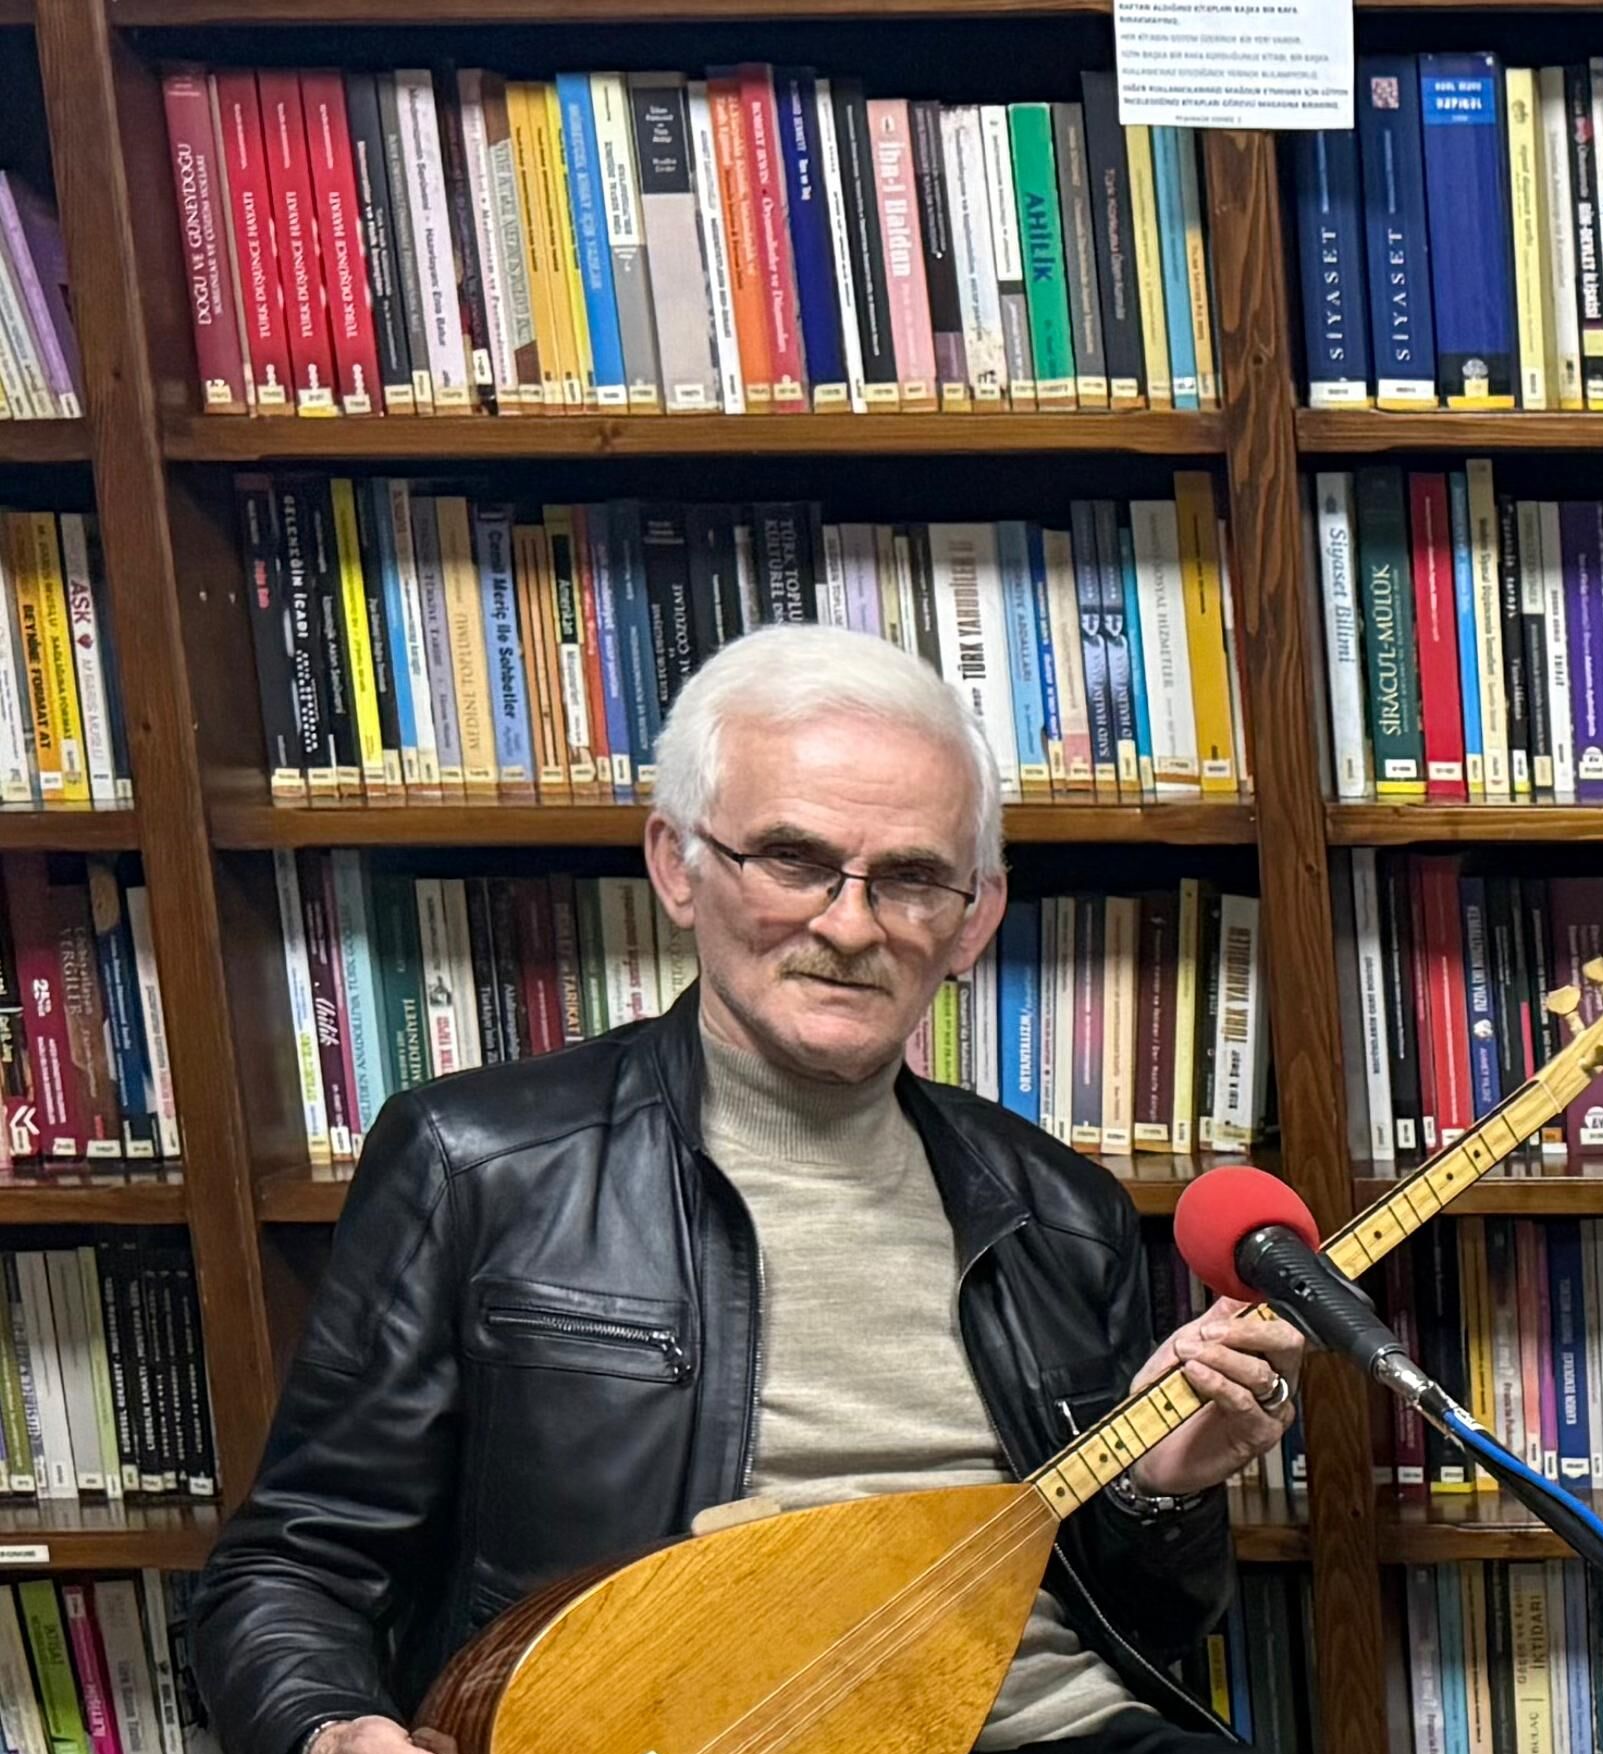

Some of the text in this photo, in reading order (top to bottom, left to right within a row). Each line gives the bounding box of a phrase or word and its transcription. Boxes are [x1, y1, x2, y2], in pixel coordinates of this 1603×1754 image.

[177, 143, 211, 325] DOĞU VE GÜNEYDOĞU
[242, 192, 258, 236] HAYATI
[285, 192, 301, 236] HAYATI
[328, 192, 344, 236] HAYATI
[892, 200, 913, 277] Haldun
[1026, 191, 1054, 282] AHİLİK
[256, 304, 271, 338] TÜRK
[299, 304, 314, 338] TÜRK
[342, 304, 357, 338] TÜRK
[1322, 227, 1346, 362] SİYASET
[1387, 228, 1412, 362] SİYASET
[764, 520, 785, 598] KÜLTÜREL
[293, 593, 310, 638] İCADI
[492, 578, 512, 621] Meriç
[558, 579, 573, 635] Amerikan
[672, 583, 690, 655] ÇÖZÜLME
[1326, 527, 1357, 664] Siyaset Bilimi
[498, 624, 512, 642] ile
[961, 641, 987, 681] TÜRK
[22, 605, 52, 750] BEYNİNE FORMAT AT
[454, 613, 480, 749] MEDİNE TOPLUMU
[499, 647, 517, 719] Sohbetler
[563, 974, 580, 1033] TARİKAT
[1223, 1006, 1248, 1043] TÜRK
[405, 998, 424, 1082] MEDENİYETİ
[1528, 1595, 1546, 1670] İKTİDARI
